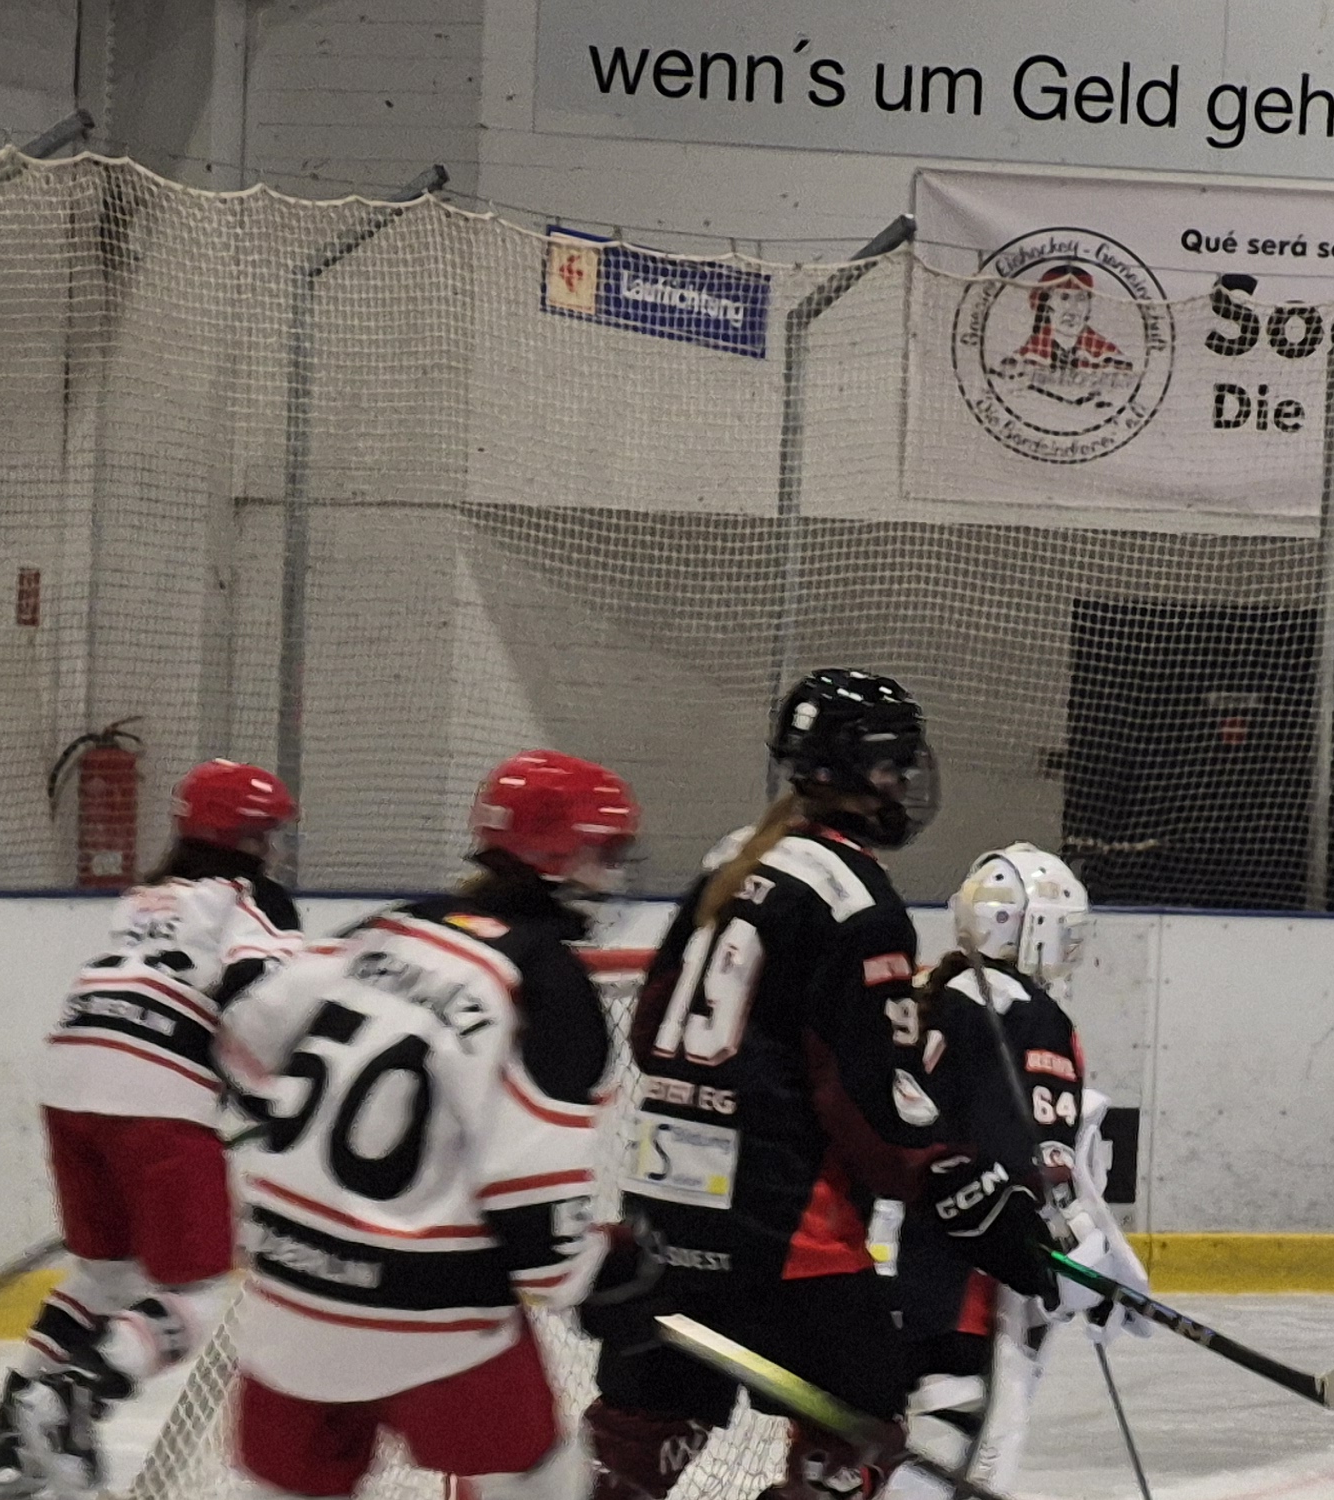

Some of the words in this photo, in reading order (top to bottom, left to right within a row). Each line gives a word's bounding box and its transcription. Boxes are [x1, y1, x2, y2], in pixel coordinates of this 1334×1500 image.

[875, 62, 983, 116] um
[1013, 54, 1180, 128] Geld
[1180, 228, 1239, 255] Qué
[1247, 233, 1308, 258] será
[1212, 382, 1306, 434] Die
[651, 915, 768, 1067] 19
[1032, 1085, 1078, 1128] 64
